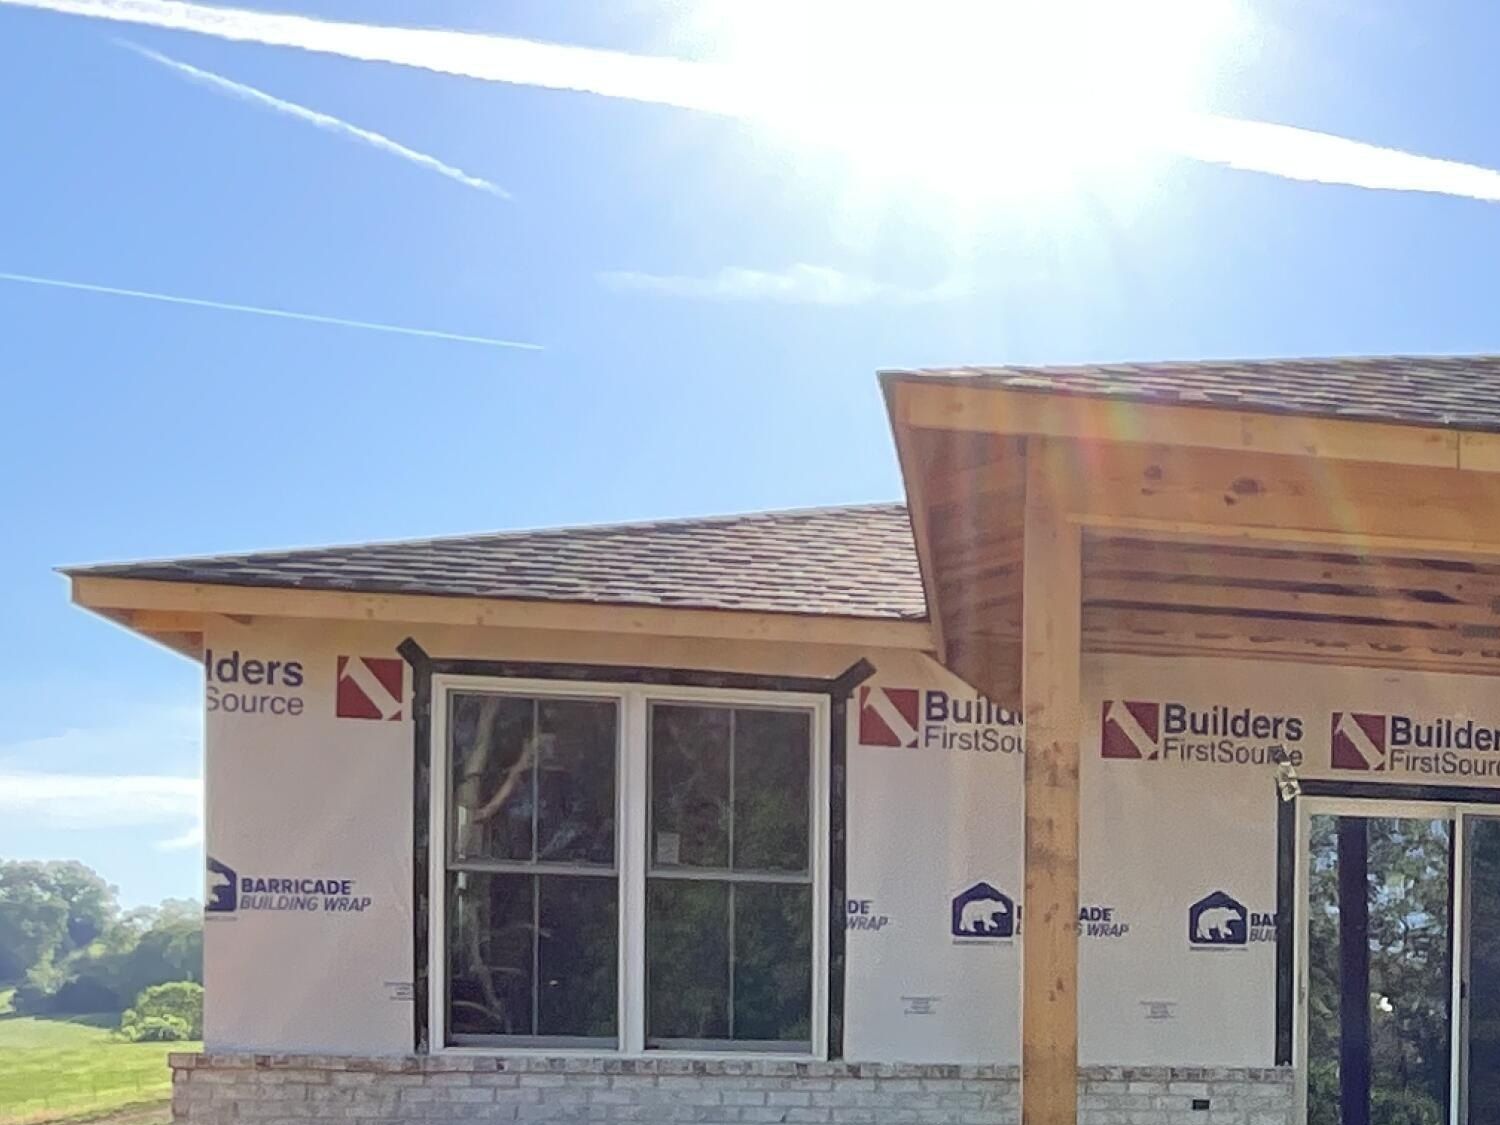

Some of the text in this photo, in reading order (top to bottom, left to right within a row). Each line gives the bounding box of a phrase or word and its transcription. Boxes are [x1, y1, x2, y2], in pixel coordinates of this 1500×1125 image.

[1165, 703, 1304, 742] Builders
[241, 878, 352, 895] BARRICADE
[240, 896, 371, 912] BUILDING WRAP
